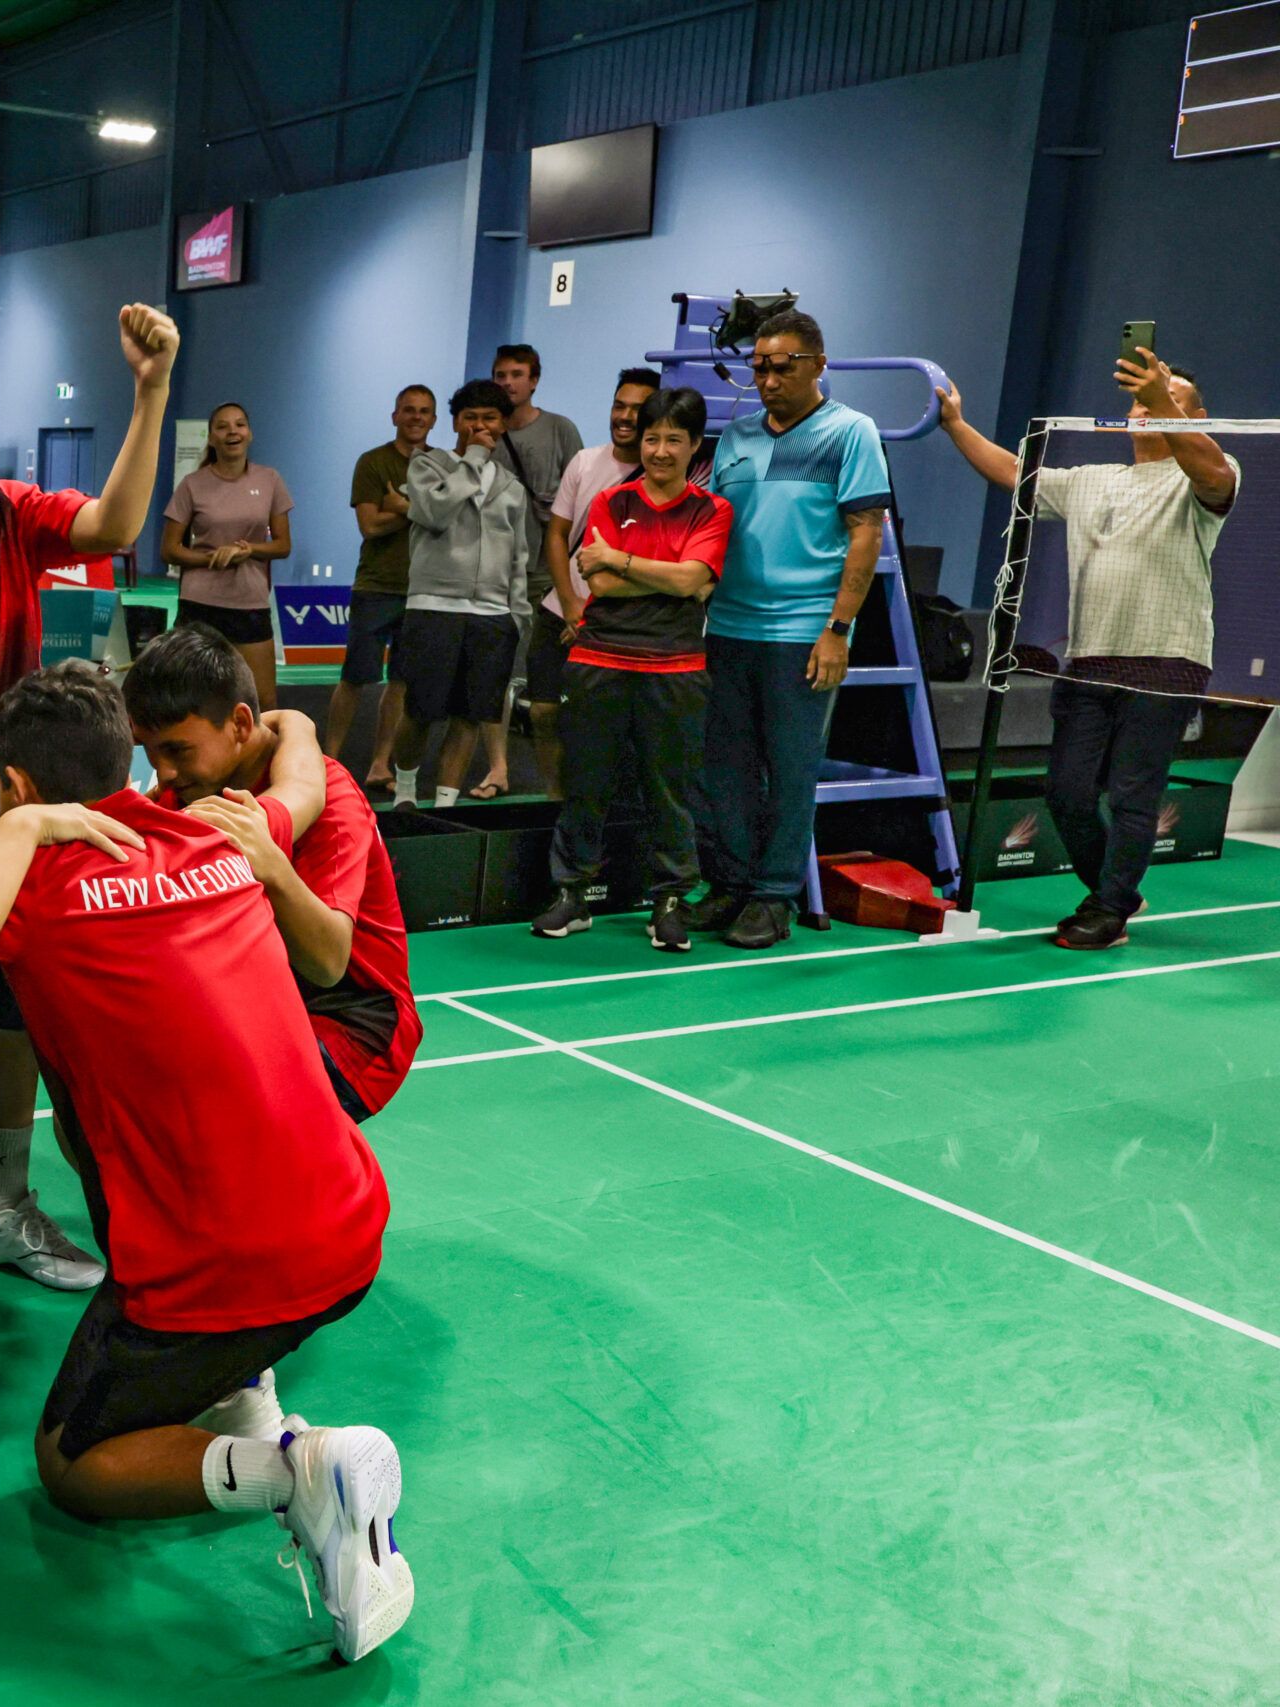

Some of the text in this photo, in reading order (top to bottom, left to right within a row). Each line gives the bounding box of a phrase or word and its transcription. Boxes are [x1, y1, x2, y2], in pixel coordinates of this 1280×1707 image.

[189, 232, 228, 261] BWF
[557, 274, 567, 292] 8
[80, 877, 148, 911] NEW
